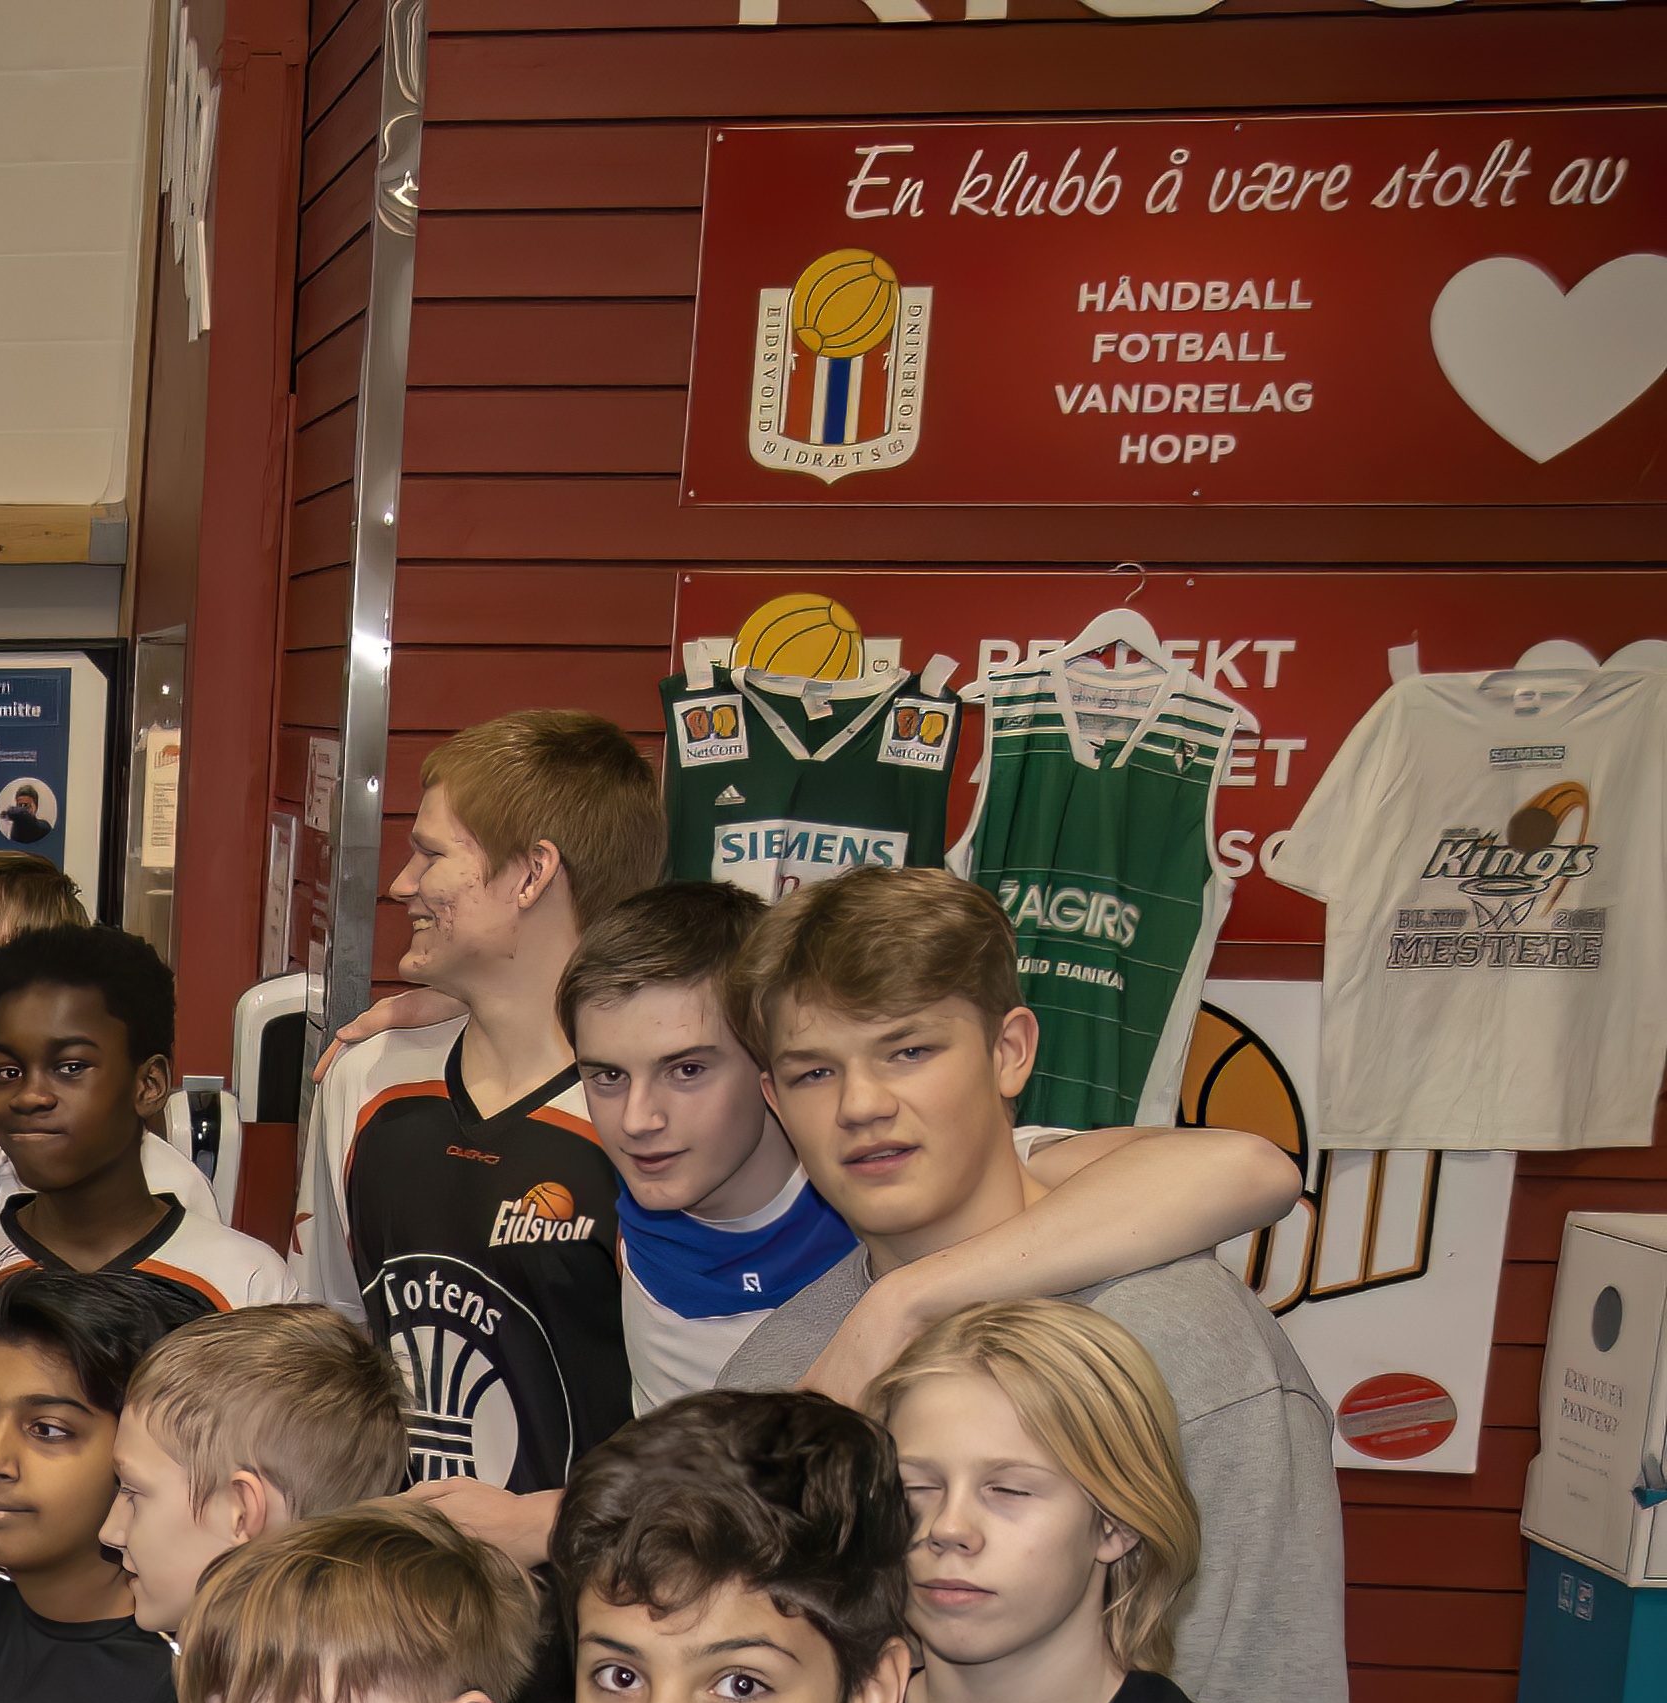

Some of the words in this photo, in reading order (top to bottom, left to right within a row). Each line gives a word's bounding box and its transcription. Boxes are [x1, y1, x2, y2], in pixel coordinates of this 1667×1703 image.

[845, 143, 924, 220] En
[949, 146, 1122, 218] klubb
[1144, 148, 1190, 215] å
[1207, 160, 1353, 214] være
[1371, 138, 1533, 210] stolt
[1549, 155, 1628, 207] av
[1077, 275, 1314, 315] HÅNDBALL
[897, 303, 923, 433] FORENING
[1091, 332, 1287, 365] FOTBALL
[758, 305, 782, 433] EIDSVOLD
[1055, 381, 1314, 415] VANDRELAG
[1119, 434, 1236, 466] HOPP
[686, 743, 742, 760] NetCom
[885, 745, 942, 764] NetCom
[720, 829, 894, 867] SIEMENS
[1421, 836, 1600, 880] Kings
[1387, 932, 1604, 970] MESTERE
[489, 1198, 596, 1248] Eidsvoll
[383, 1270, 502, 1336] Totens
